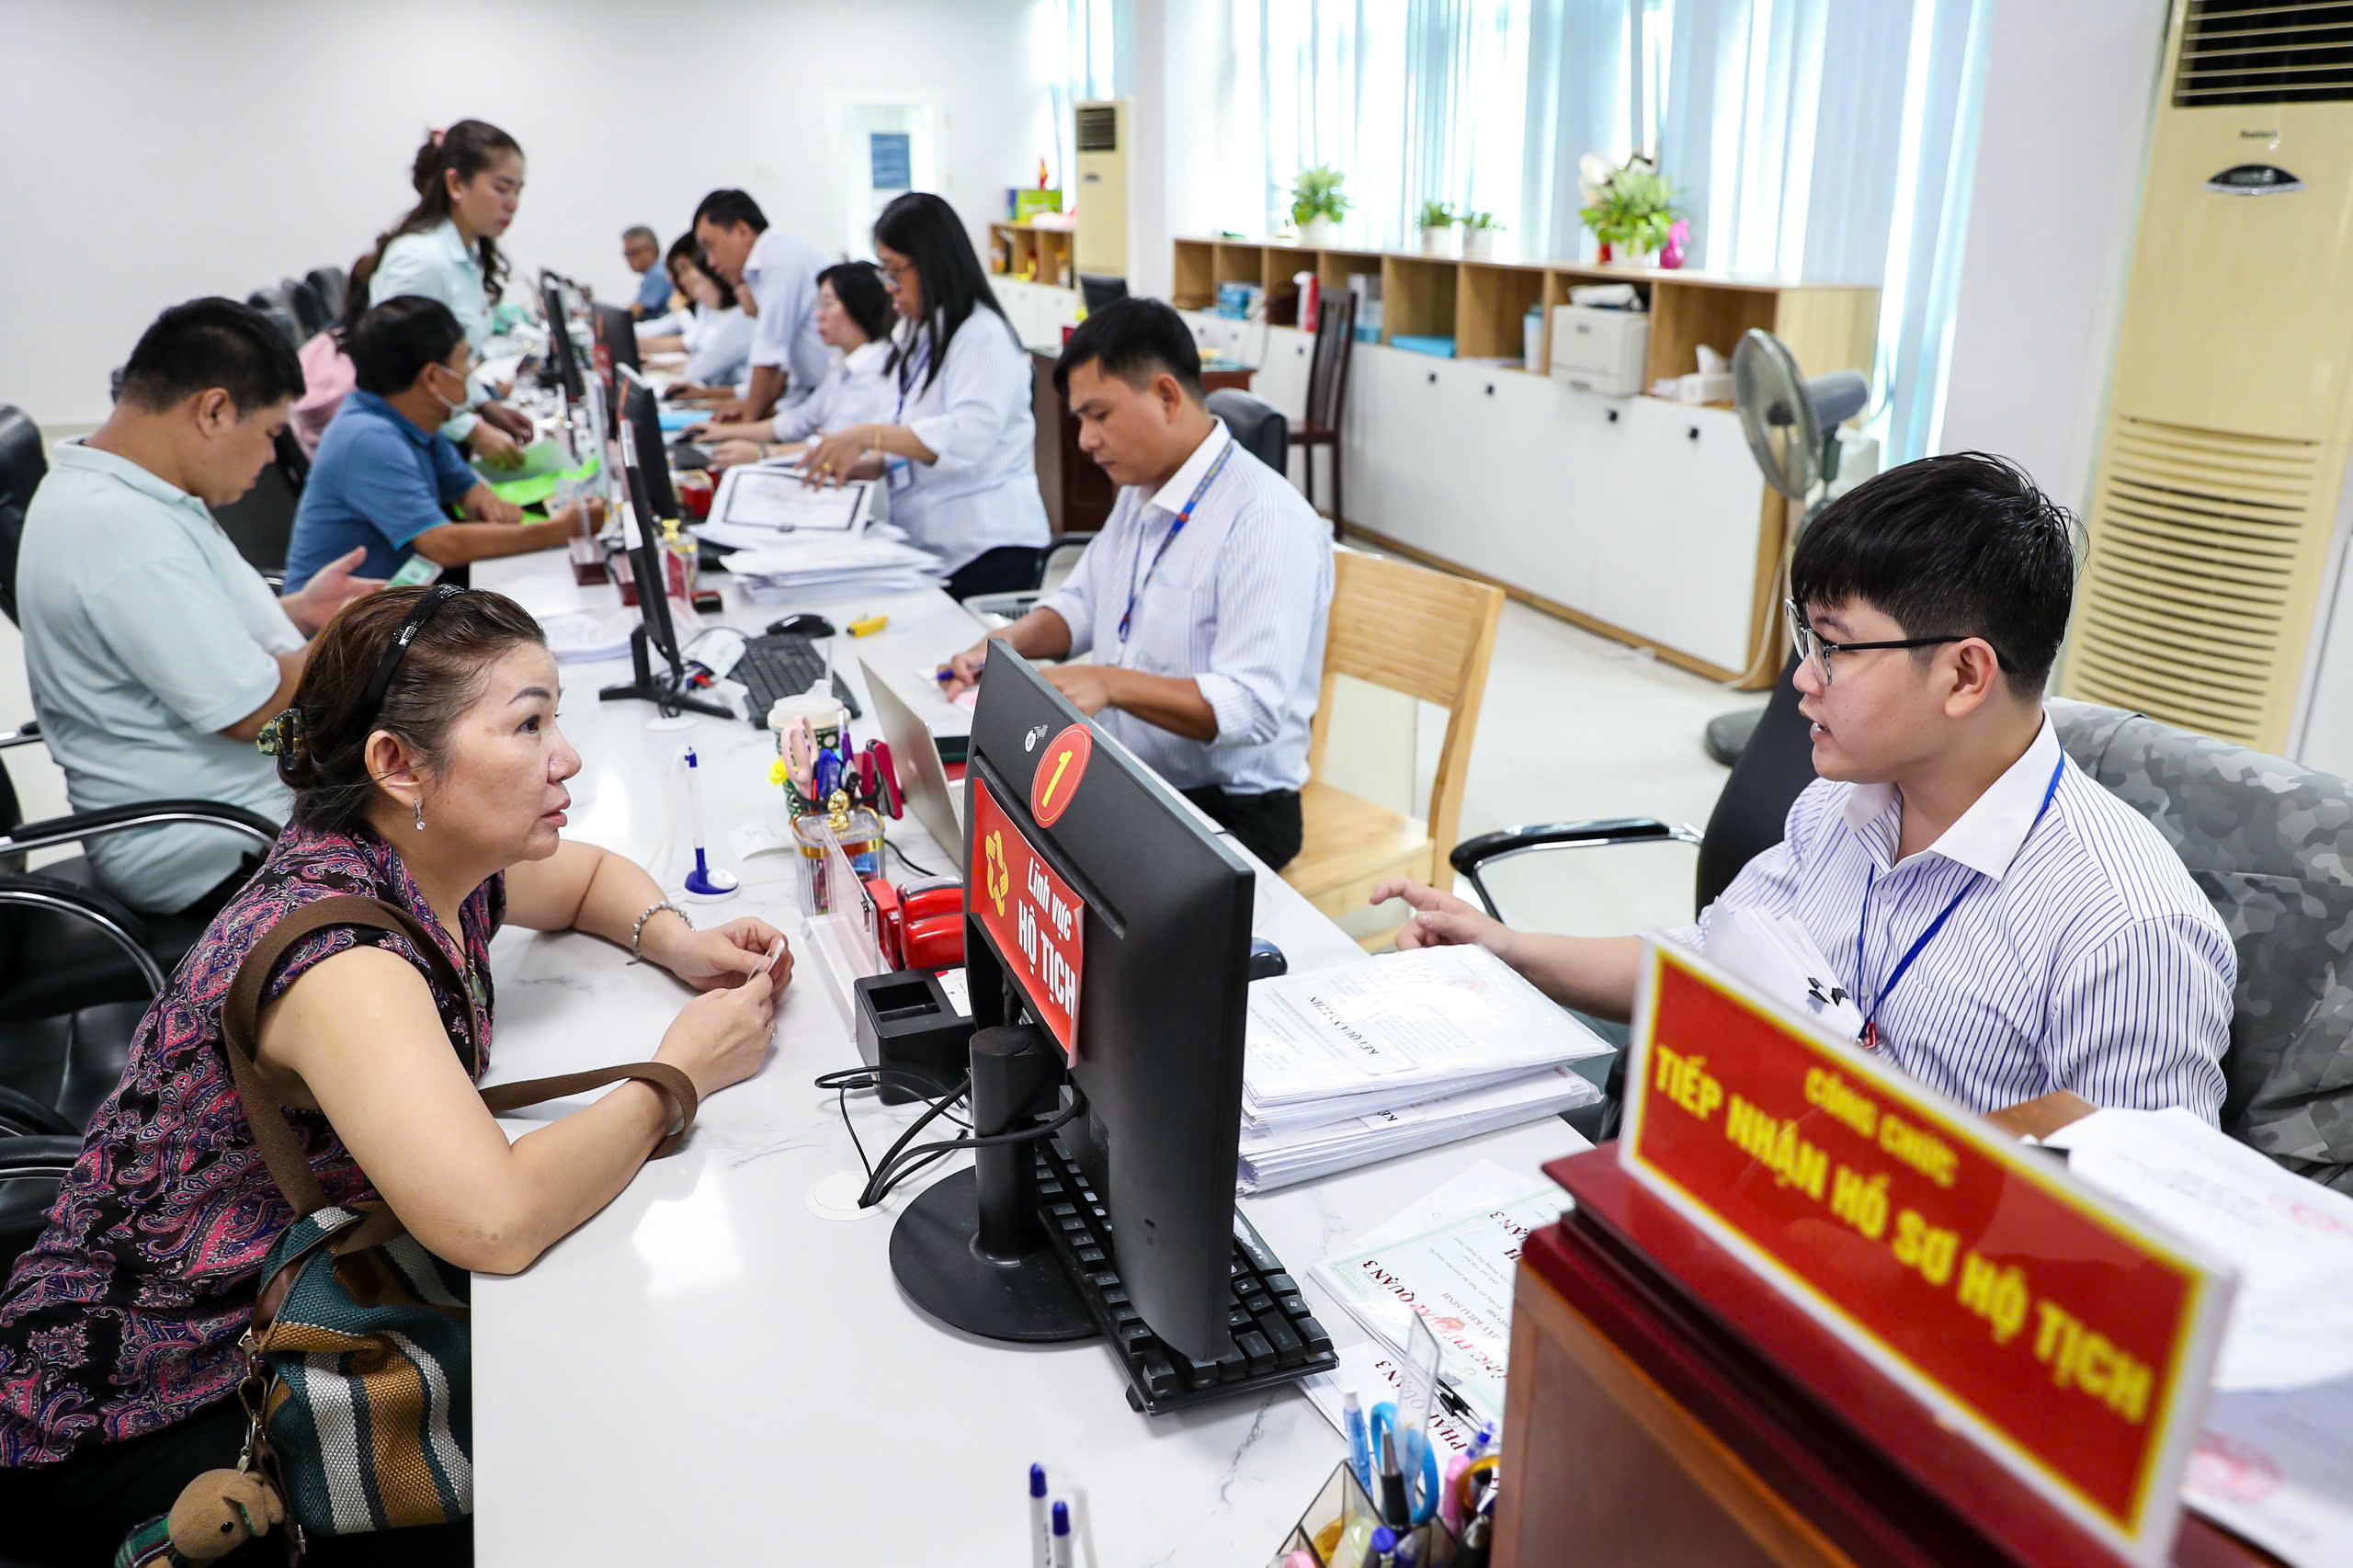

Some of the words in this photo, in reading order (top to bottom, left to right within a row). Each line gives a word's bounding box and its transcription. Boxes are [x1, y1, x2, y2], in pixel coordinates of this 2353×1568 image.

[1041, 749, 1073, 808] 1
[1028, 857, 1050, 913] Lĩnh
[1051, 891, 1073, 942] vực
[1017, 898, 1038, 975] HỘ
[1040, 933, 1077, 1020] TỊCH
[1655, 1045, 1723, 1120] TIẾP
[1726, 1093, 1829, 1201] NHẬN
[1892, 1208, 1961, 1286] SƠ
[1957, 1249, 2029, 1346] HỘ
[2032, 1298, 2154, 1422] TỊCH
[1362, 1260, 1378, 1269] 3
[1370, 1267, 1415, 1303] QUẬN
[1374, 1360, 1392, 1369] 3
